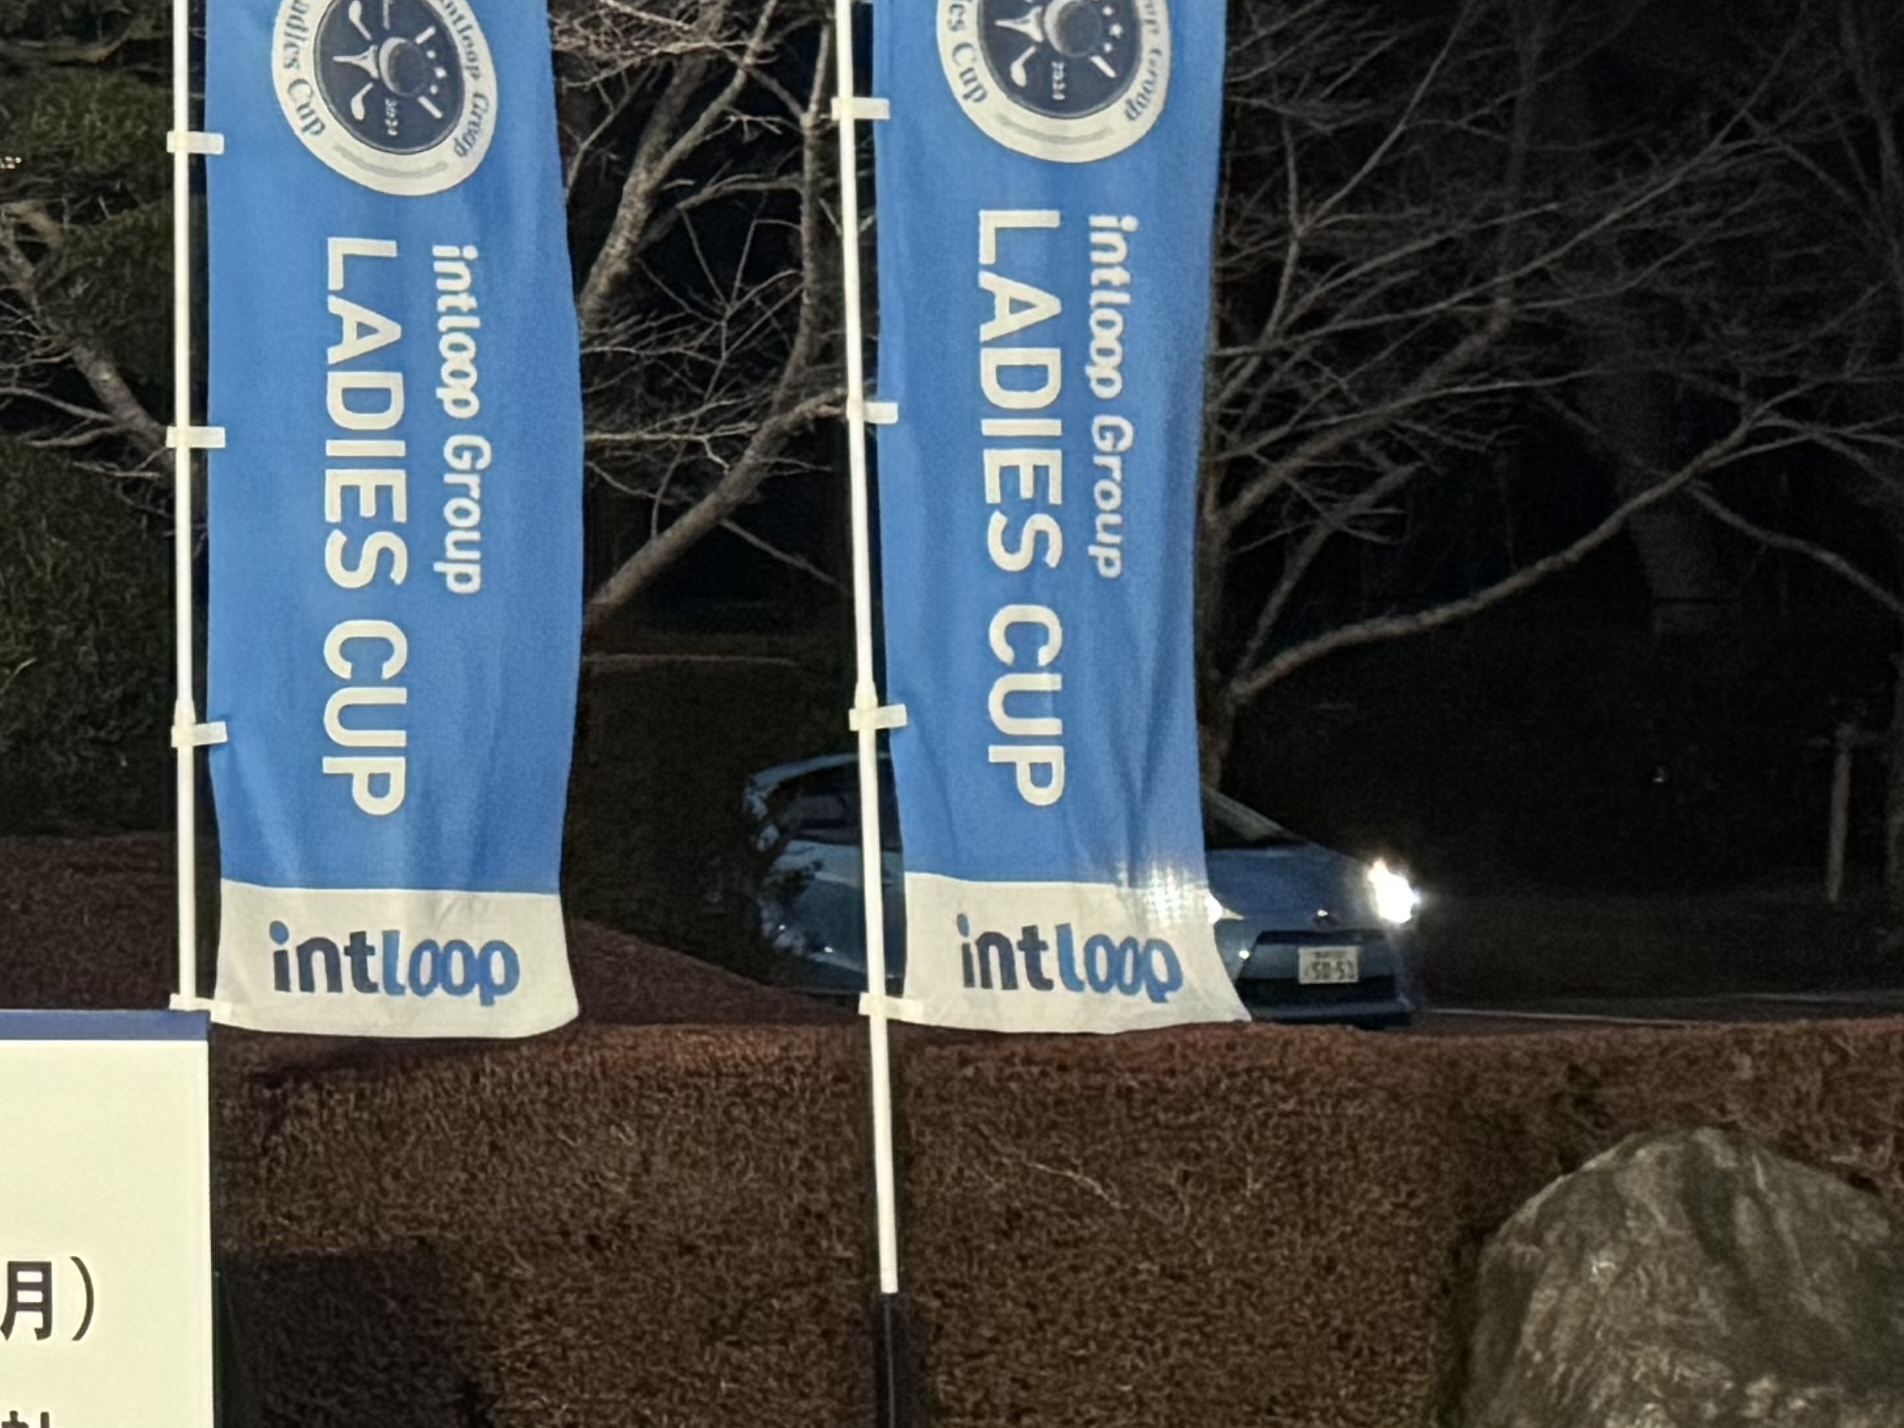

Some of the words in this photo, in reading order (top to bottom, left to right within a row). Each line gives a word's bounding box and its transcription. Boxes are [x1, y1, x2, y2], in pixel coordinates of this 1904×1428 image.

[288, 78, 326, 137] Cup
[952, 42, 988, 103] Cup
[432, 245, 480, 419] intloop
[978, 209, 1062, 572] LADIES
[1086, 214, 1138, 399] intloop
[325, 237, 408, 589] LADIES
[1087, 414, 1134, 579] Group
[433, 434, 492, 594] Group
[322, 619, 408, 816] CUP
[987, 604, 1065, 807] CUP
[269, 921, 520, 1006] intloop
[957, 913, 1183, 1003] intloop
